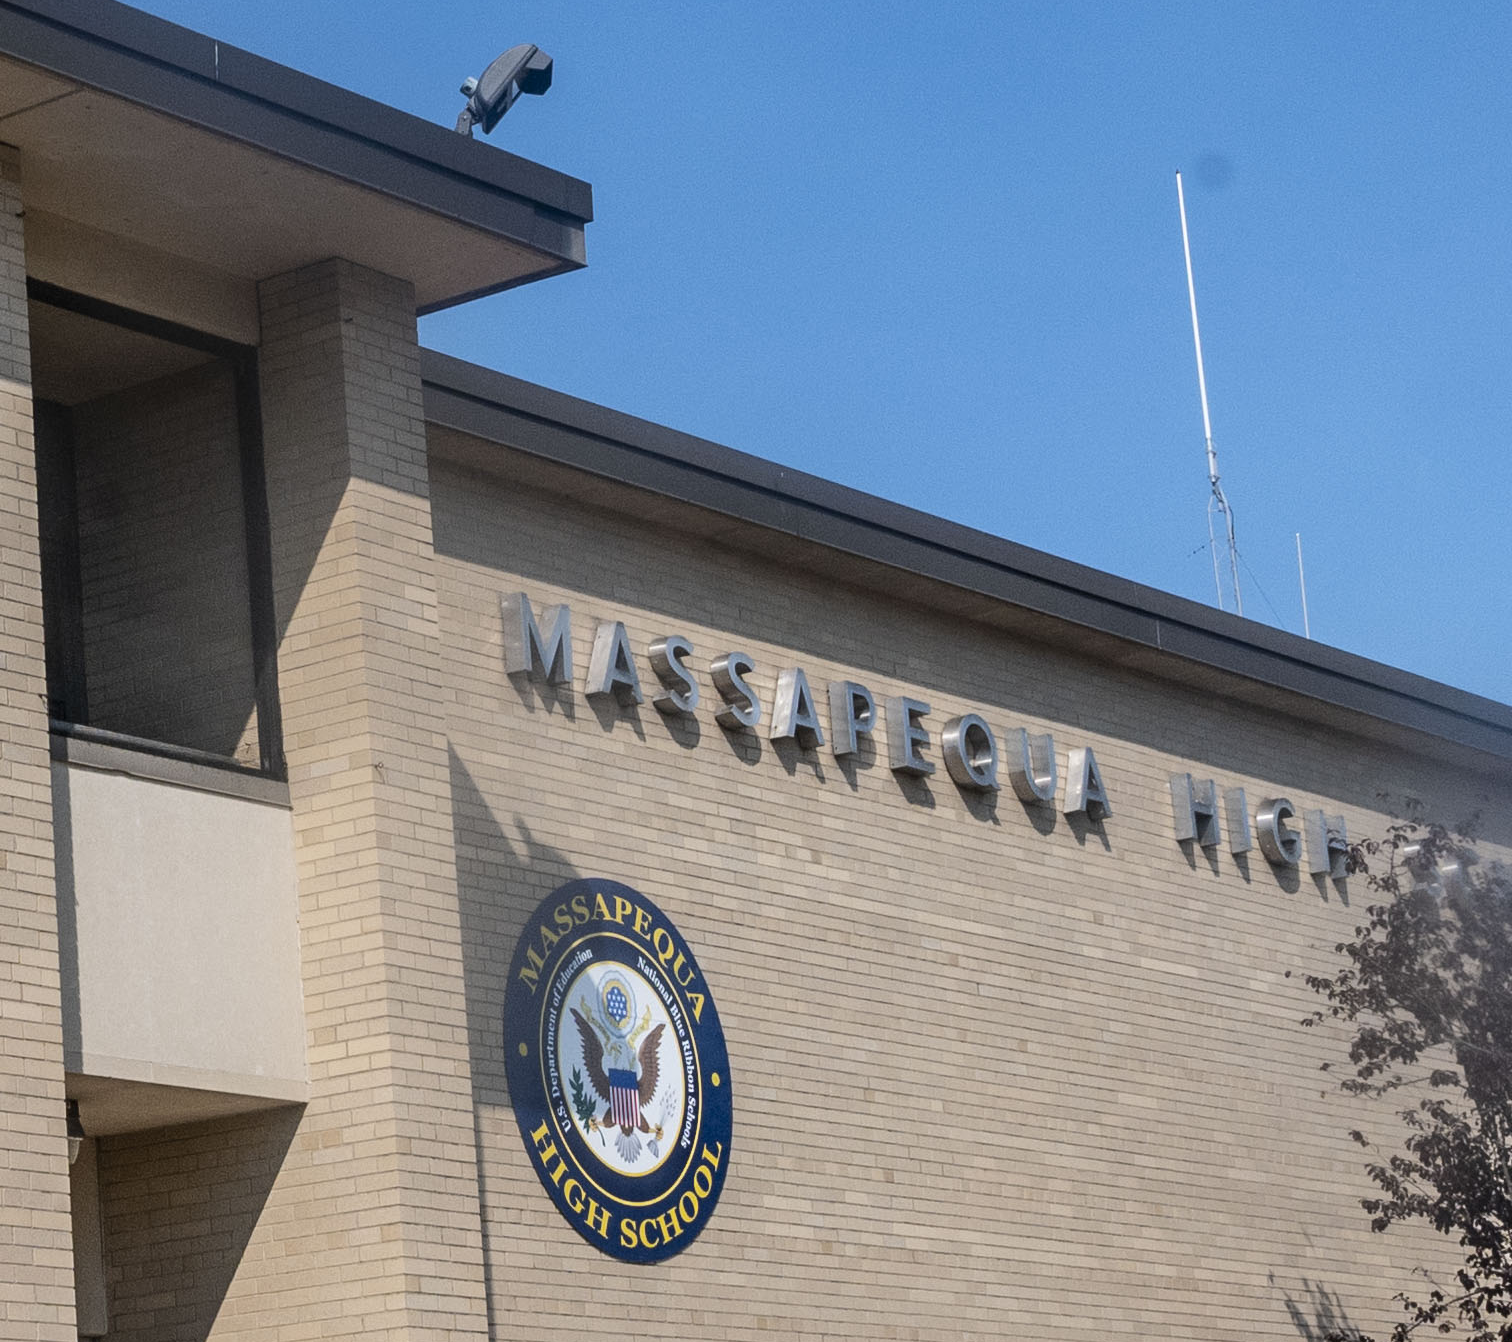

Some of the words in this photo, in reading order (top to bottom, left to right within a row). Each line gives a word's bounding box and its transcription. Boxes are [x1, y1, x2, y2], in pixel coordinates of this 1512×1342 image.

[500, 591, 1112, 819] MASSAPEQUA
[1169, 772, 1349, 876] HIGH
[519, 892, 705, 1025] MASSAPEQUA
[556, 948, 593, 993] Education
[637, 955, 673, 1006] National
[552, 987, 562, 1006] of
[669, 1003, 686, 1038] Blue
[546, 1008, 560, 1099] Department
[681, 1039, 695, 1092] Ribbon
[556, 1100, 572, 1133] U.S.
[680, 1094, 697, 1149] Schools
[530, 1118, 613, 1240] HIGH
[620, 1141, 723, 1249] SCHOOL
